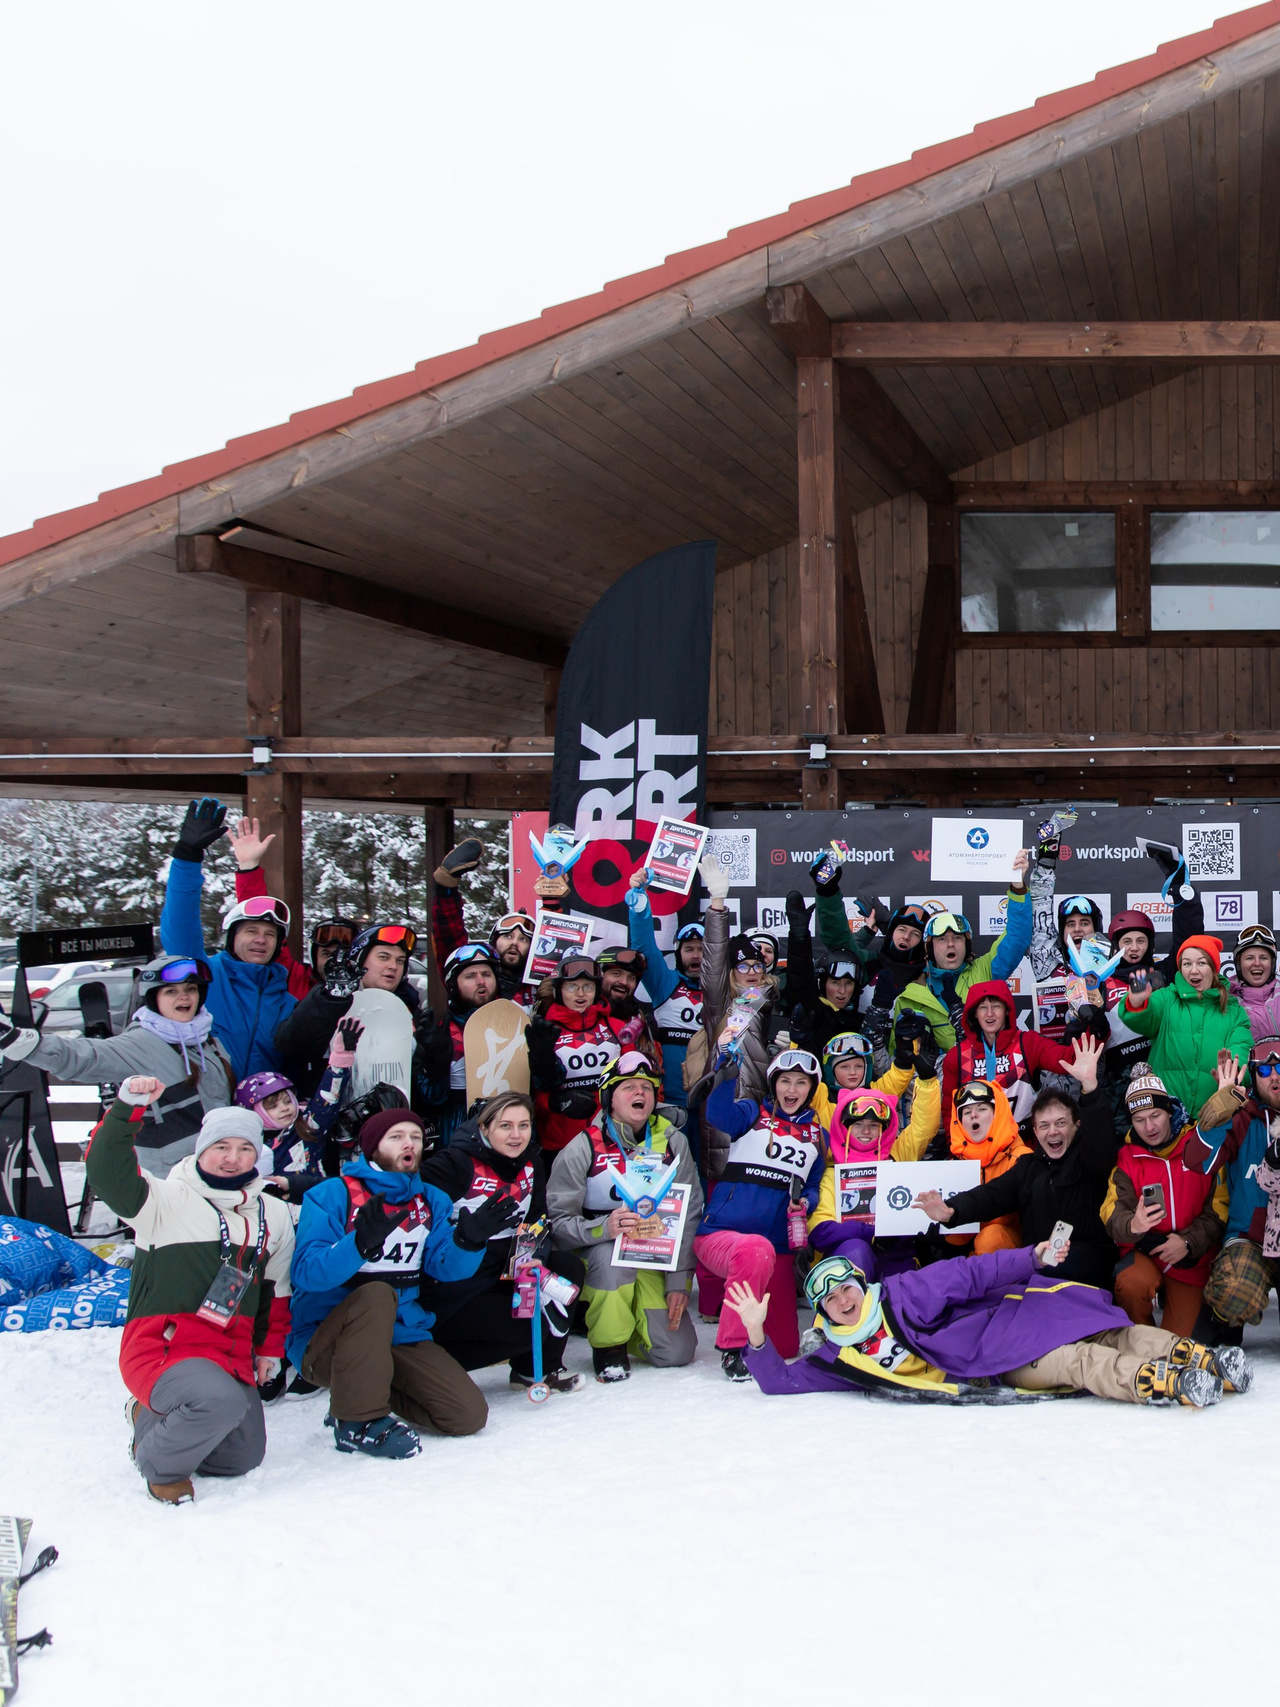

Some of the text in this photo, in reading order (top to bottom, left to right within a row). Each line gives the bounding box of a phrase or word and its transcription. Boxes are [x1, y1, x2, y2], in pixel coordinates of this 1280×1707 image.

[1076, 846, 1151, 863] workspor
[1220, 900, 1238, 916] 78
[550, 919, 579, 930] ДИПЛОМ
[80, 939, 94, 952] ТЫ
[95, 937, 135, 951] МОЖЕШЬ
[568, 1051, 610, 1070] 002
[973, 1054, 1010, 1068] WRK
[973, 1063, 1012, 1078] SPRT
[765, 1141, 807, 1169] 023
[848, 1168, 877, 1178] ДИПЛОМ
